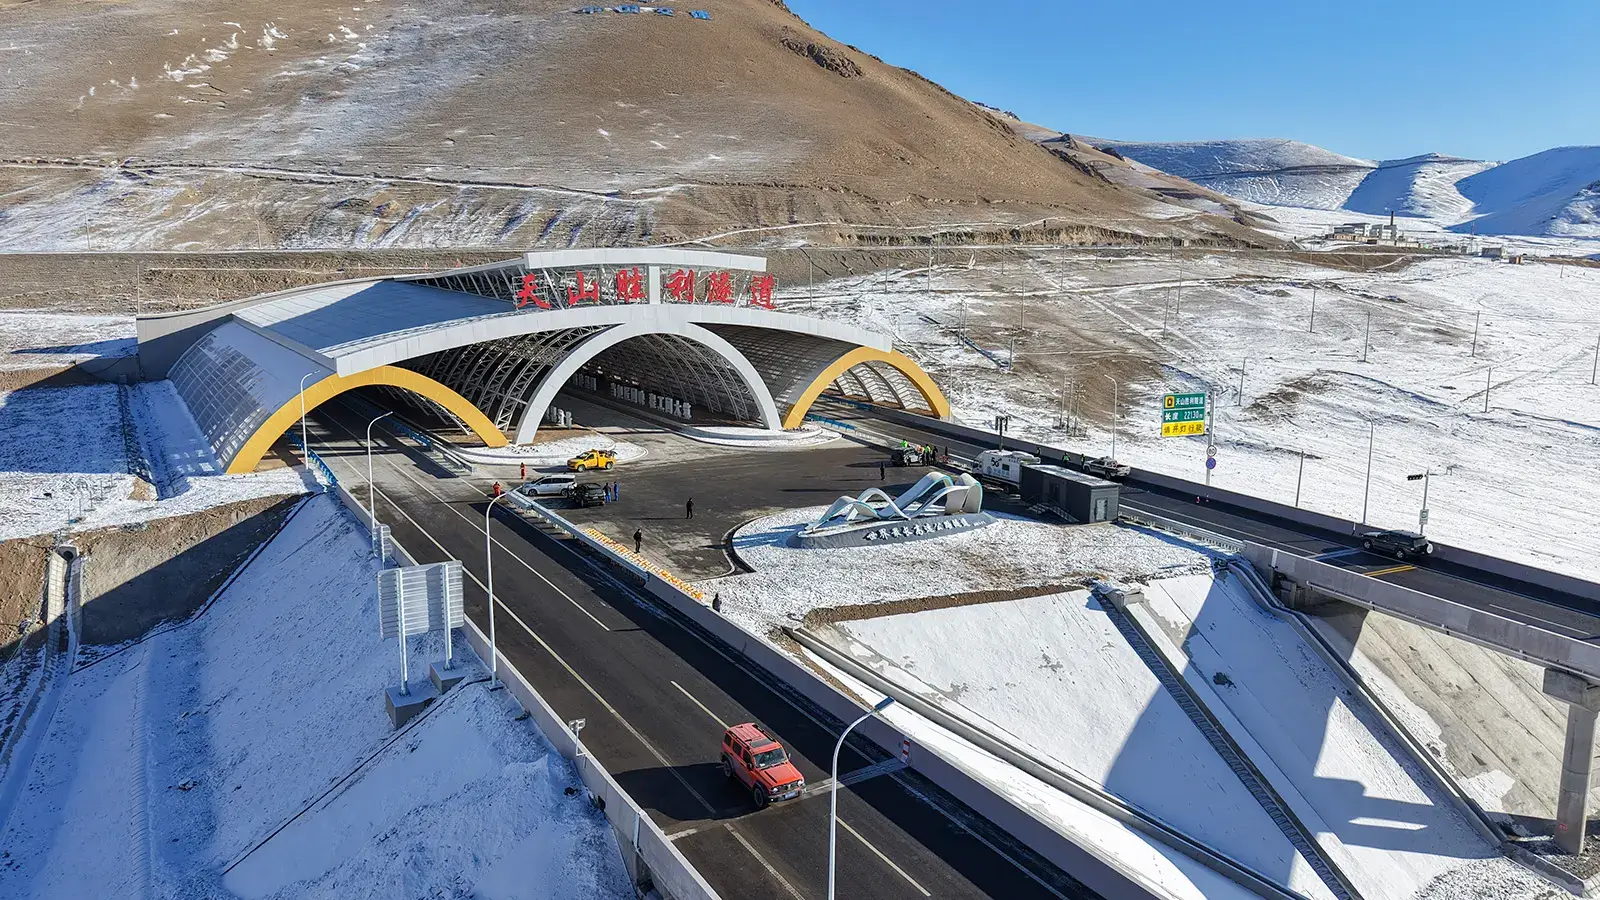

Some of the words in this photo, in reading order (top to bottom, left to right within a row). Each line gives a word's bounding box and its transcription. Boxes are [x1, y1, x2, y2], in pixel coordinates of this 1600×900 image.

[517, 266, 777, 310] 天山胜利隧道
[1176, 397, 1203, 405] 天山胜利隧道
[1165, 412, 1179, 421] 长度
[1164, 424, 1202, 433] 请开灯行驶
